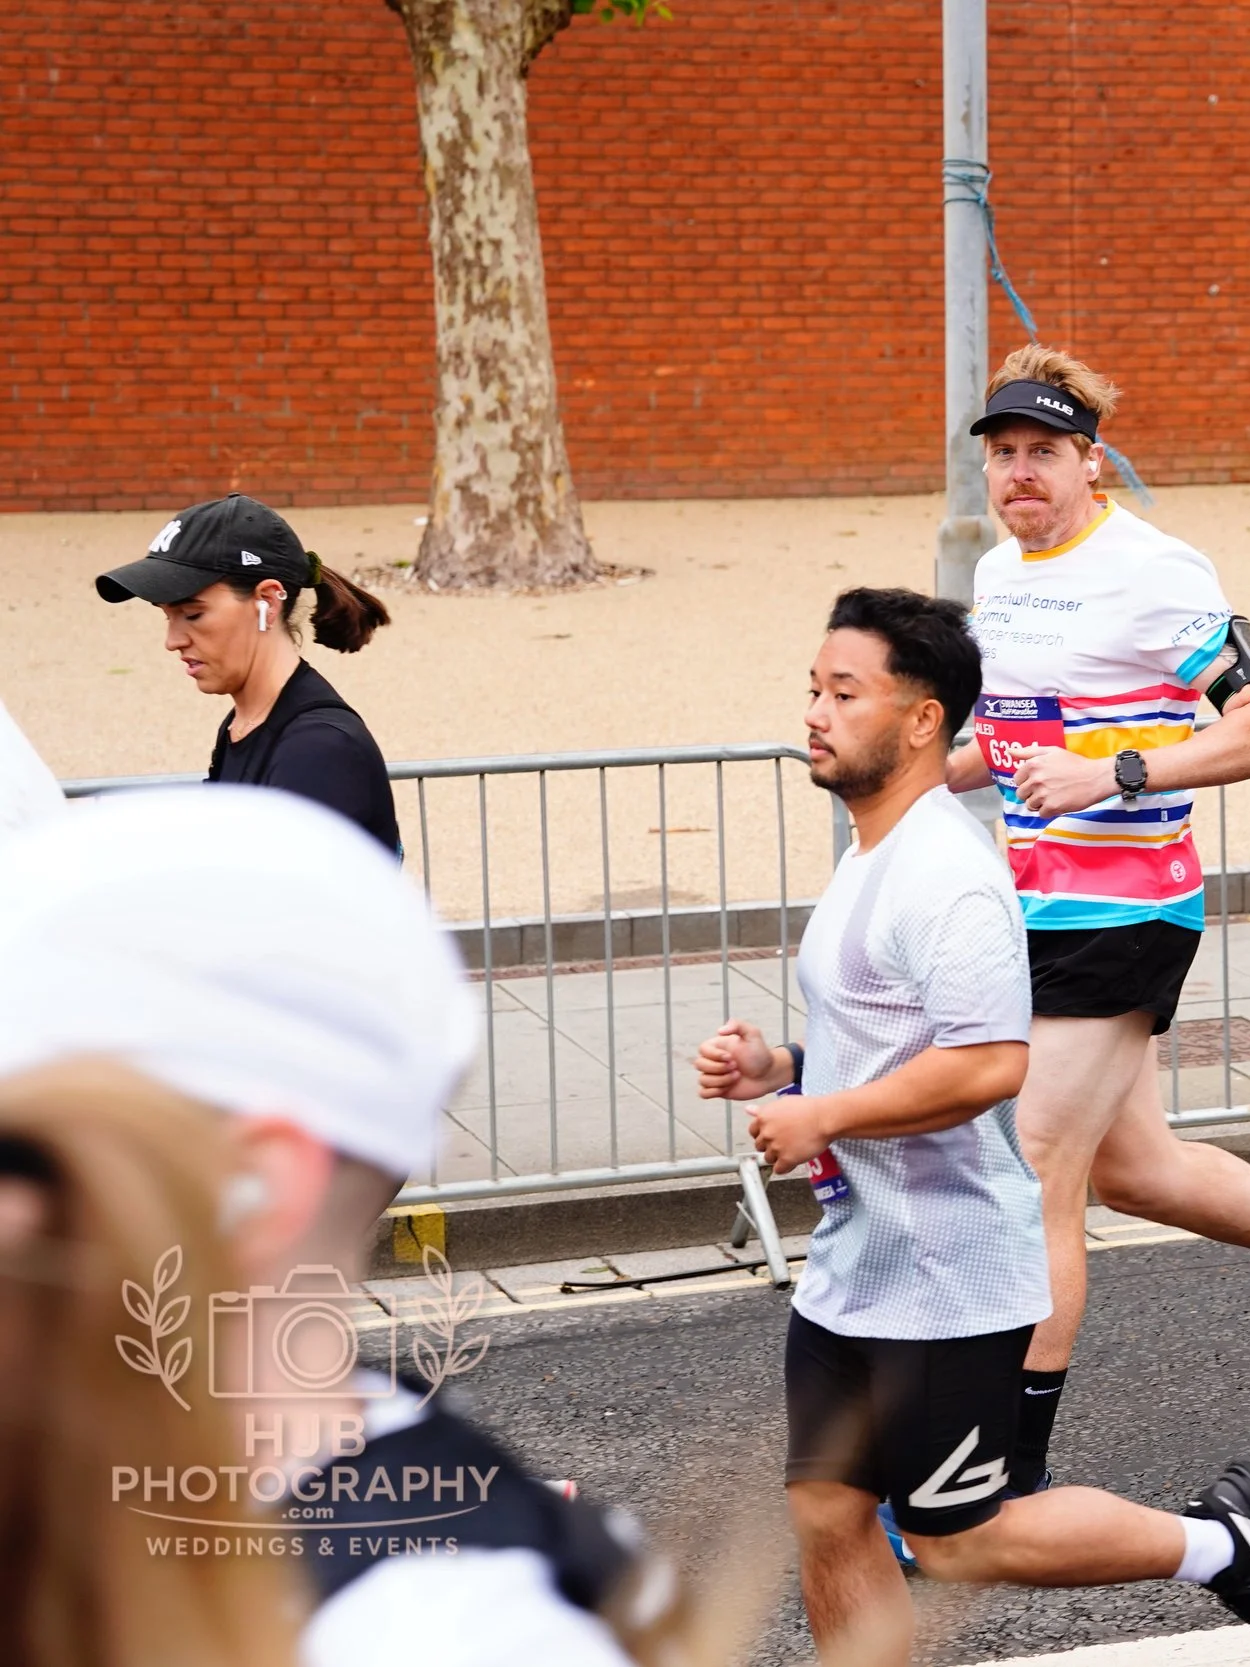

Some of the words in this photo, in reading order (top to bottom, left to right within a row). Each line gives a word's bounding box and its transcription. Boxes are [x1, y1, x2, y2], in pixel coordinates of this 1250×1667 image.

[1036, 396, 1074, 416] HUUB
[1032, 597, 1083, 612] canser
[1000, 699, 1037, 708] SWANSEA
[989, 739, 1039, 769] 63
